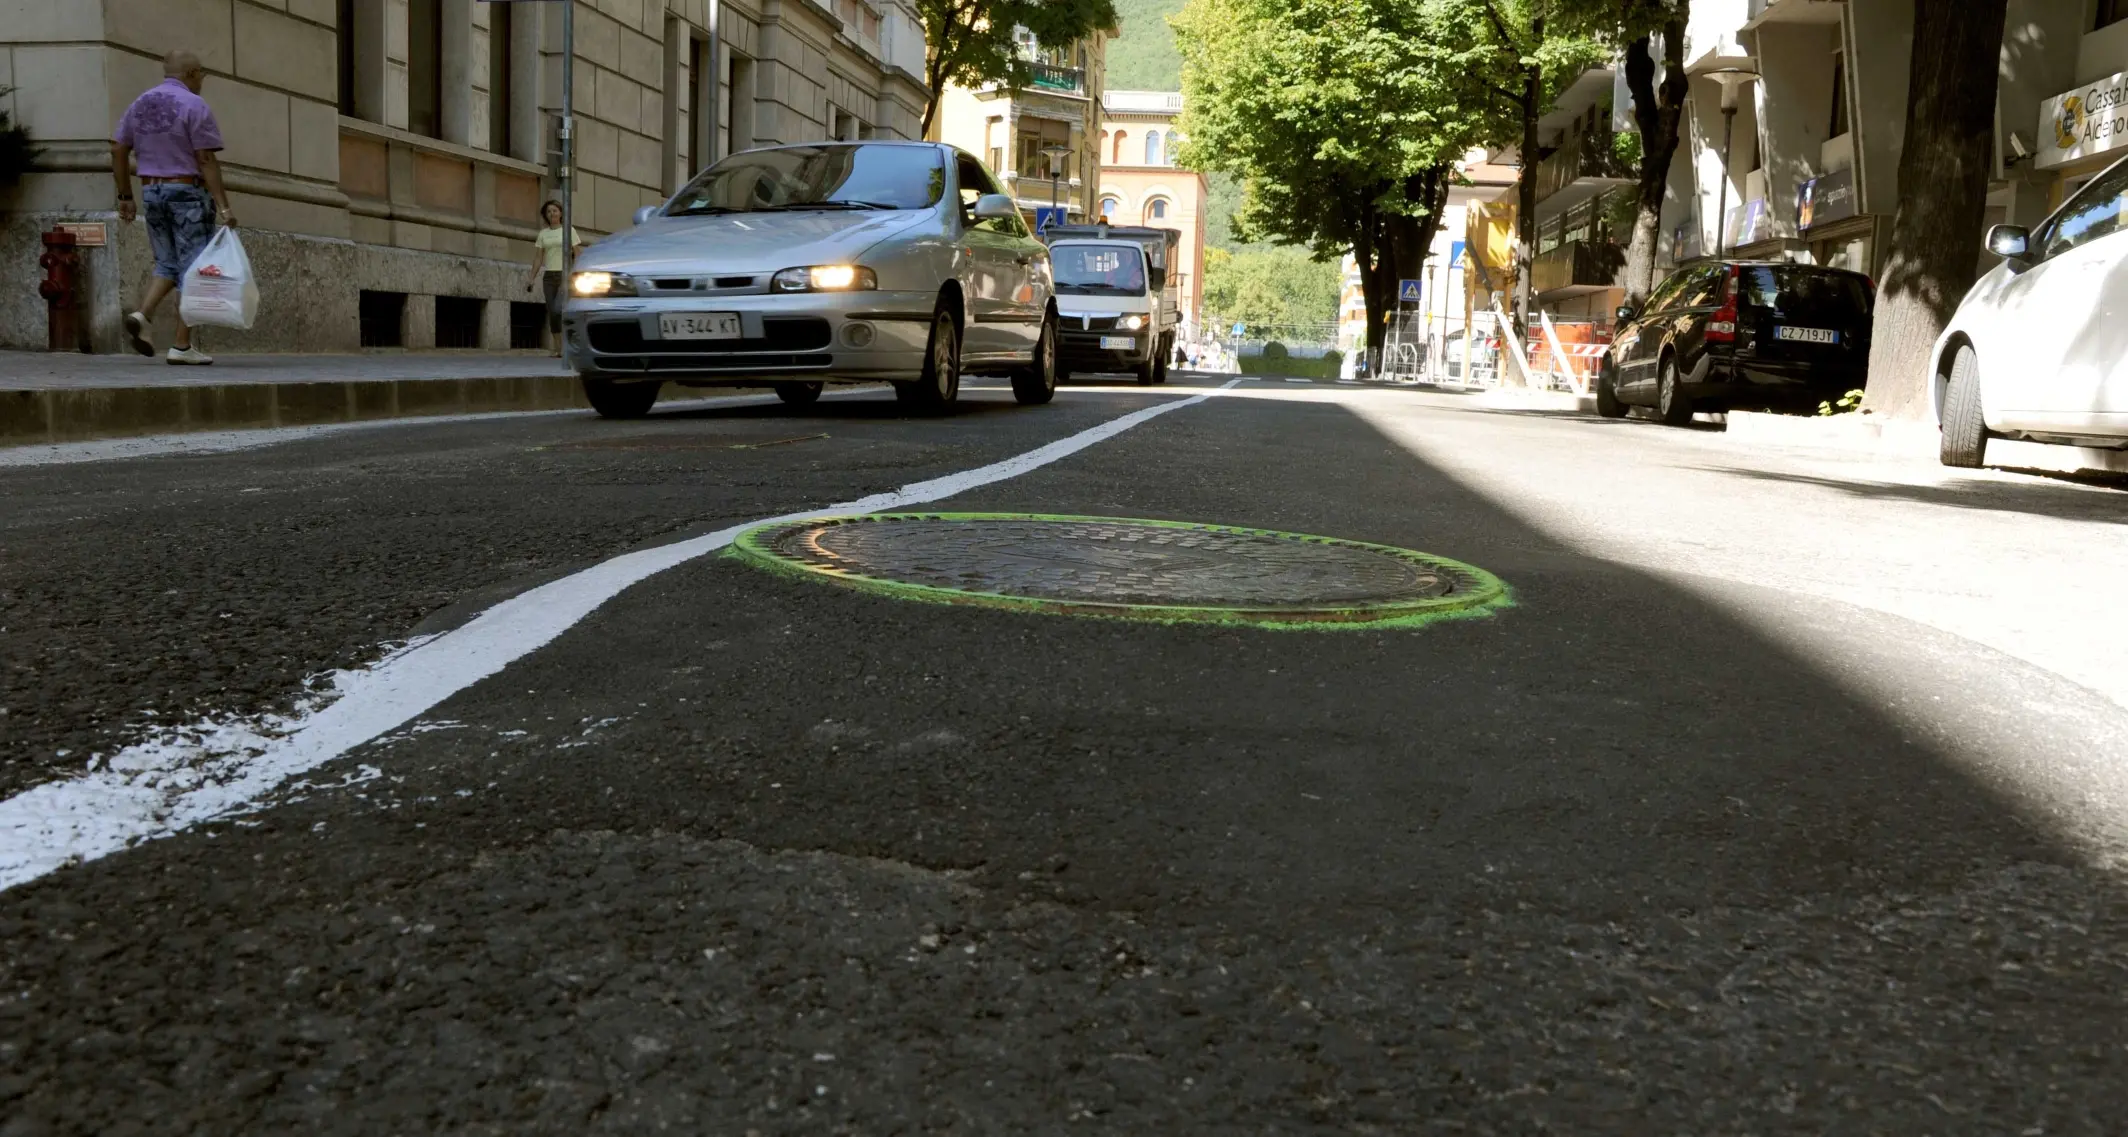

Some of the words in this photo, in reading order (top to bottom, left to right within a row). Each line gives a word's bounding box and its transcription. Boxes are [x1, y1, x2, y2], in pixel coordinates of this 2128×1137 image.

[2085, 85, 2122, 114] Cassa
[2082, 115, 2125, 144] Aldeno
[719, 318, 737, 334] KT
[1781, 327, 1795, 340] CZ
